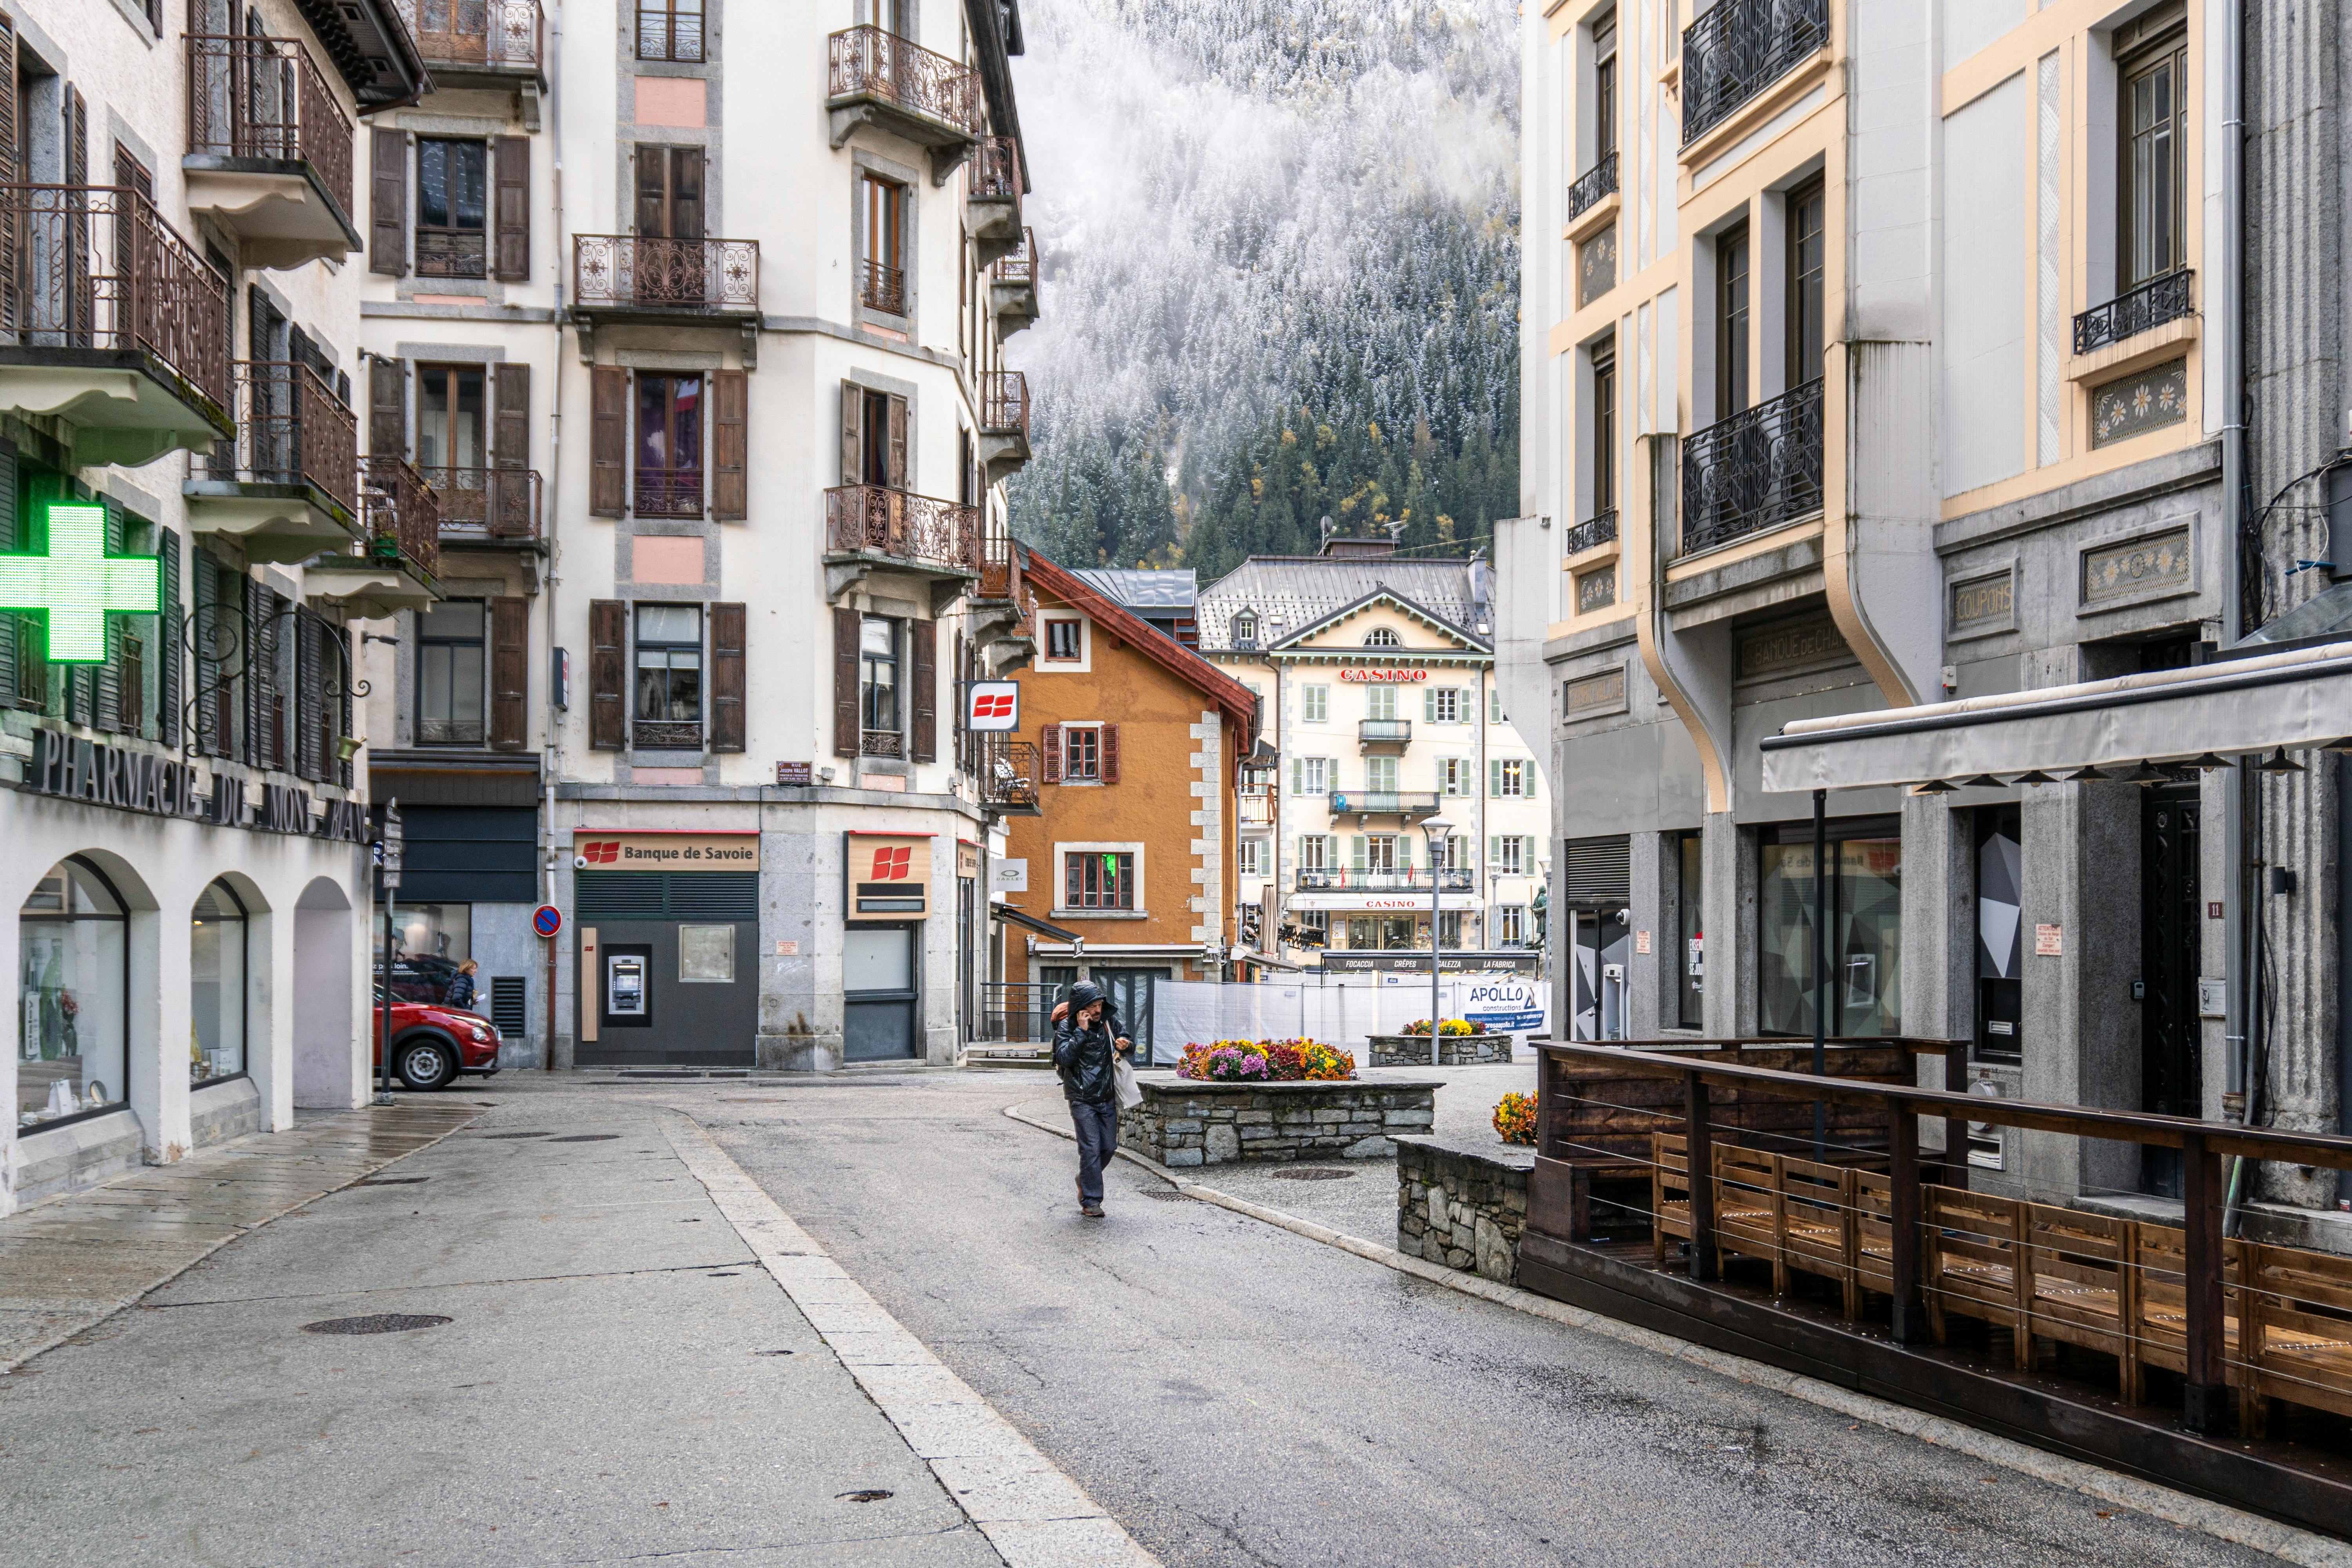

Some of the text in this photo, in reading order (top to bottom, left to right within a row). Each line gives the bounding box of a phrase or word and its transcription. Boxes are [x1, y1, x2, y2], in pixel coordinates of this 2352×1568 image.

[1958, 583, 2011, 619] COUPONS
[1755, 634, 1800, 665] BANQUE
[1340, 668, 1427, 681] CASINO
[38, 728, 370, 844] PHARMACIE DU MONT BLANC
[624, 846, 753, 862] Banque de Savoie
[2212, 904, 2219, 915] 11
[1394, 959, 1416, 967] CRÊPES
[1689, 951, 1699, 963] TOUT
[1689, 963, 1695, 975] SE
[1470, 987, 1523, 1002] APOLLO
